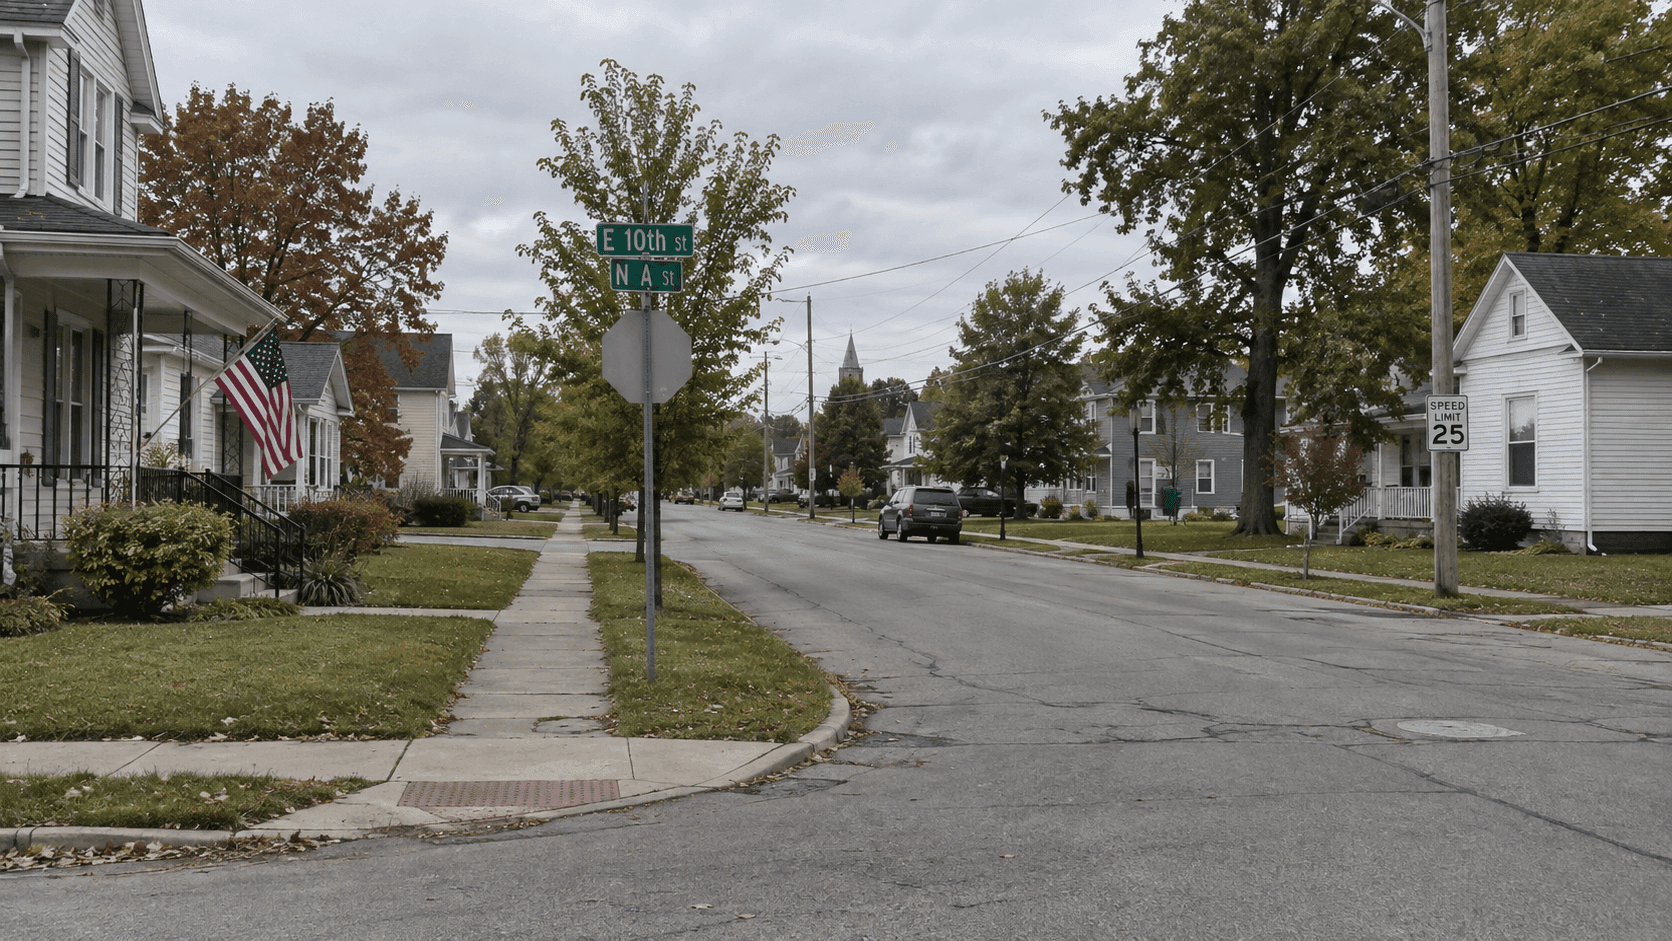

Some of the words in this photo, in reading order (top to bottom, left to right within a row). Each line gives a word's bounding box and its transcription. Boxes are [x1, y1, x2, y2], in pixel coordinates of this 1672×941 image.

[603, 228, 615, 251] E
[624, 228, 666, 251] 10th
[616, 263, 628, 286] N
[641, 263, 652, 287] A
[1430, 401, 1465, 410] SPEED
[1434, 413, 1461, 421] LIMIT
[1432, 424, 1464, 444] 25
